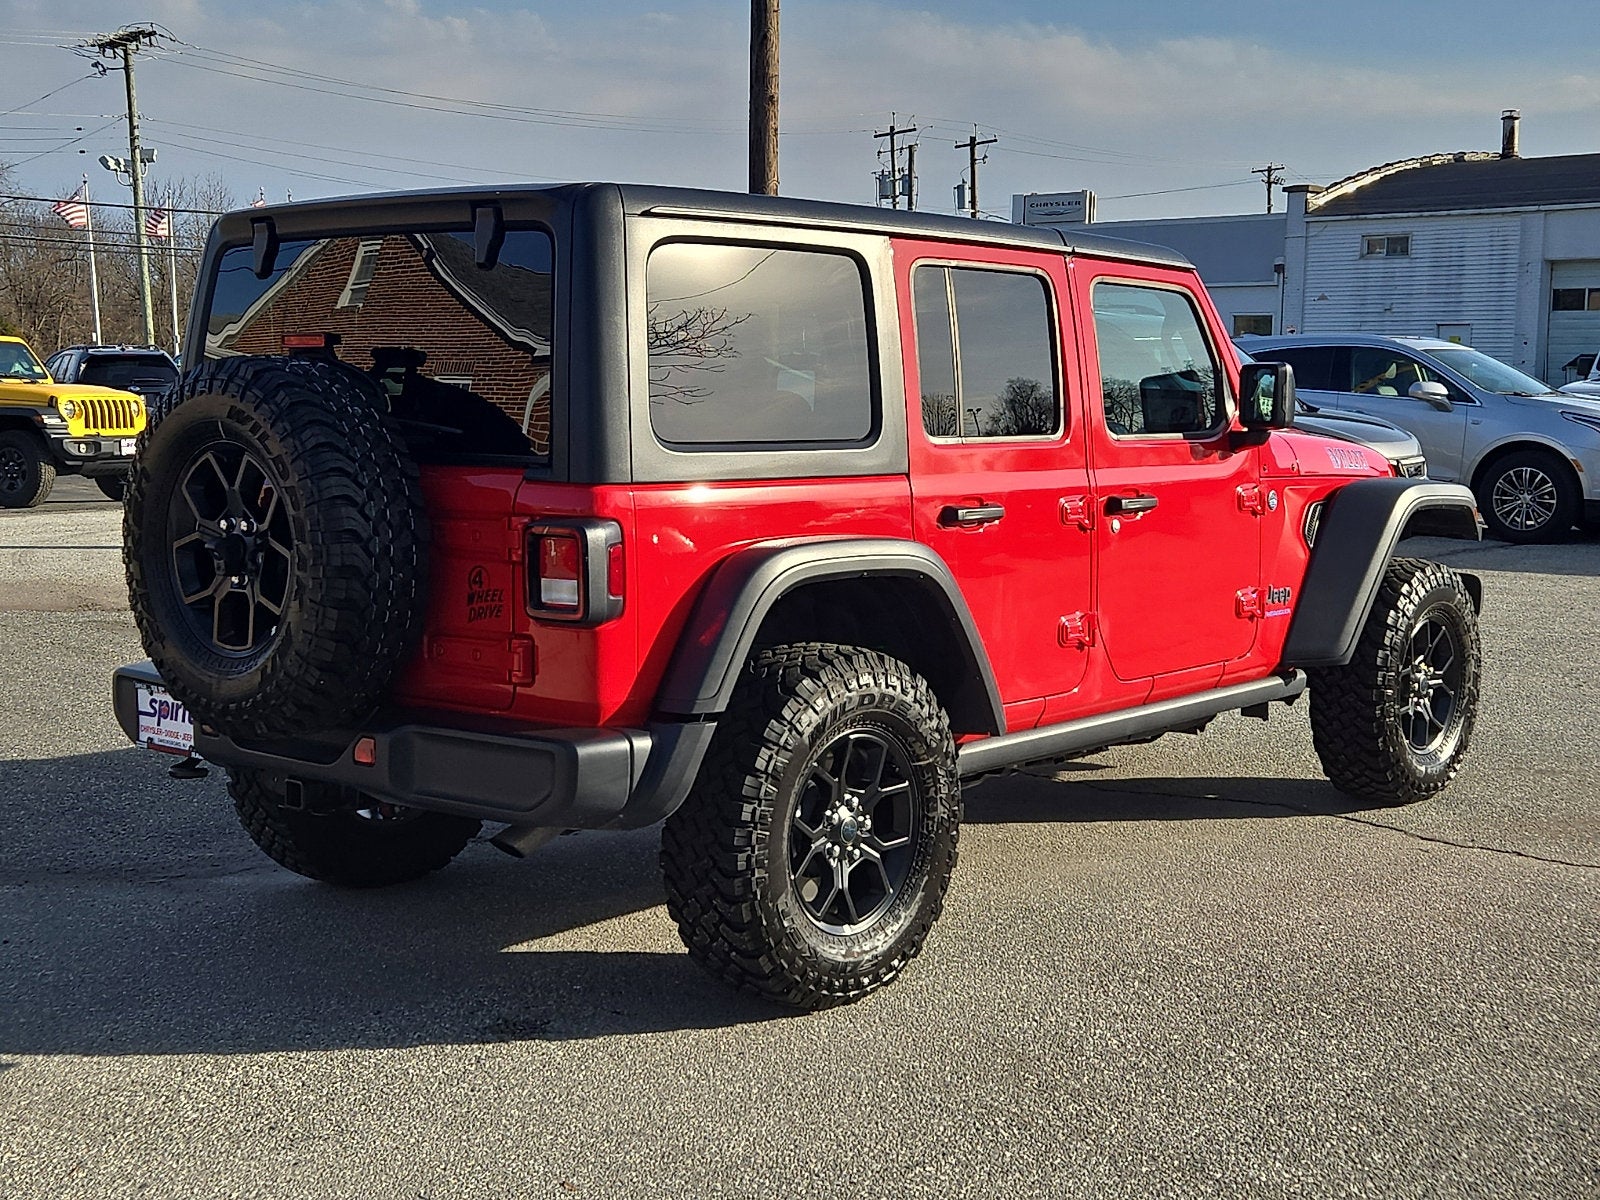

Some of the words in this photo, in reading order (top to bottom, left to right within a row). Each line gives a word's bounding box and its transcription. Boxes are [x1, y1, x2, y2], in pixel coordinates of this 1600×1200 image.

[1029, 200, 1082, 209] CHRYSLER
[471, 569, 483, 589] 4
[467, 588, 504, 607] WHEEL
[1266, 584, 1292, 606] Jeep
[467, 604, 503, 623] DRIVE
